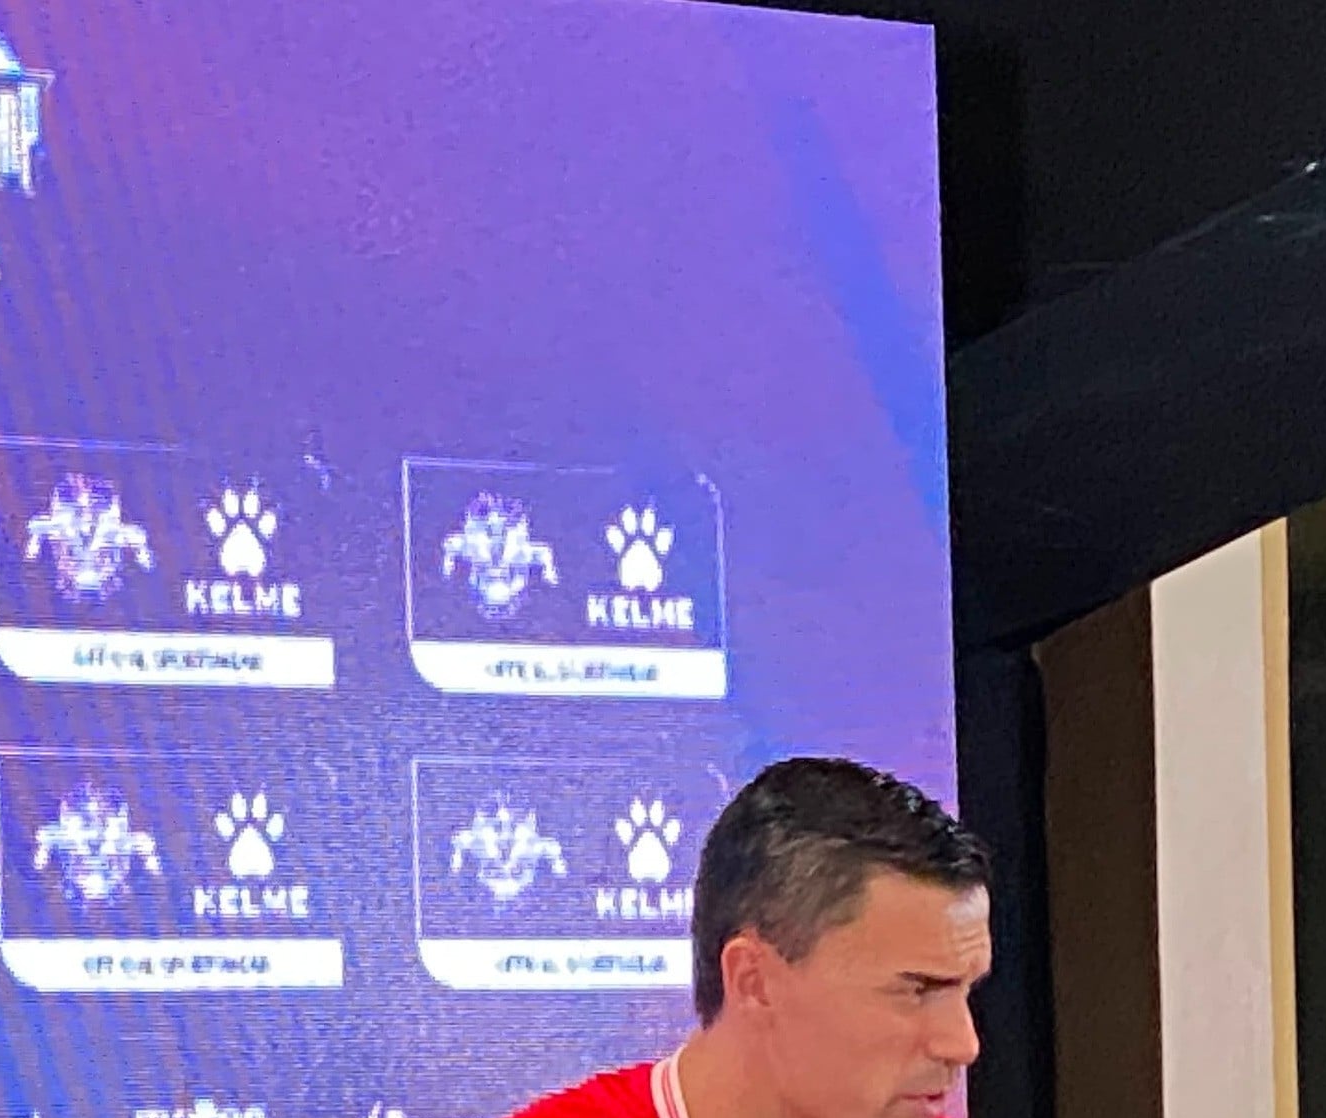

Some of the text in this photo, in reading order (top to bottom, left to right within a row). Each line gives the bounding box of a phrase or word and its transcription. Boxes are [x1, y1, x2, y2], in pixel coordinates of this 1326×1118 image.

[186, 580, 301, 617] KELME
[586, 594, 694, 629] KELME
[193, 887, 309, 917] KELME
